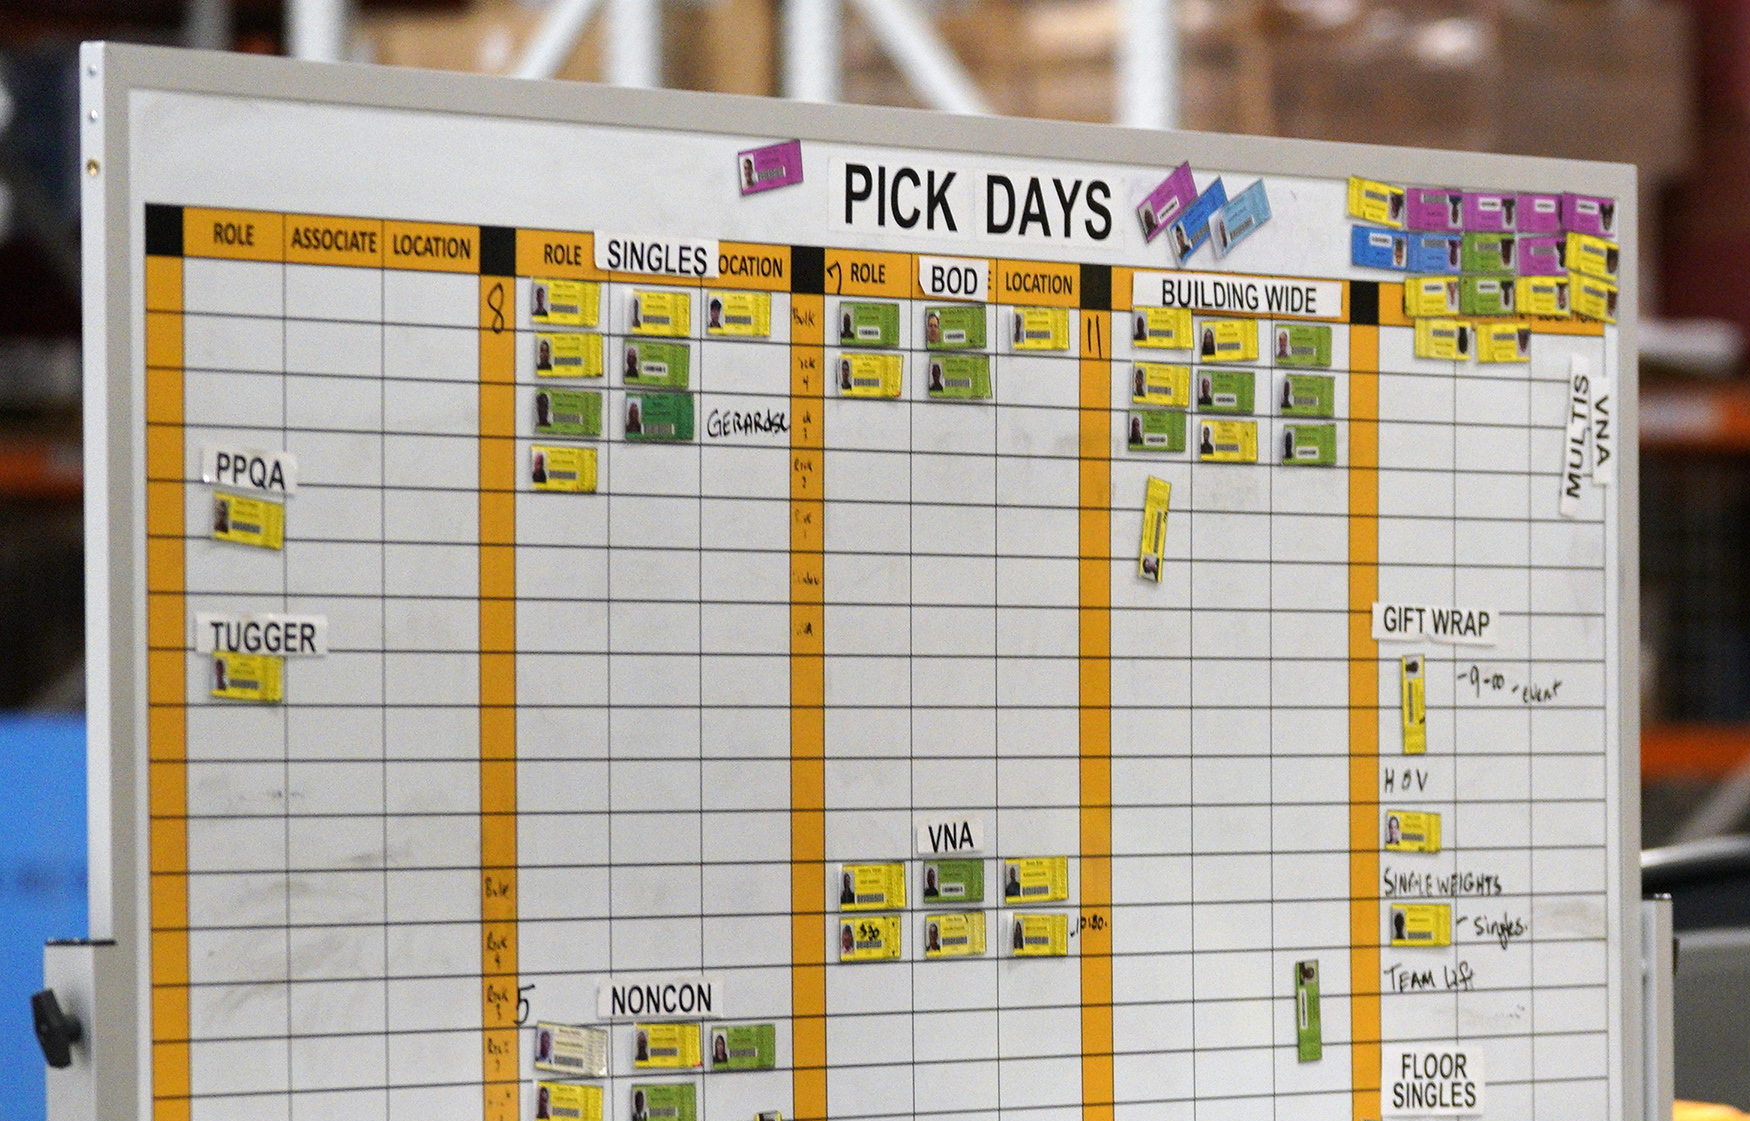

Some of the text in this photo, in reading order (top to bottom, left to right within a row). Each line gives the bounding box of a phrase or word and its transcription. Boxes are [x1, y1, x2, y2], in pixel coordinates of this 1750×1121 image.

[845, 163, 957, 232] PICK
[986, 174, 1112, 240] DAYS
[213, 222, 254, 246] ROLE
[291, 227, 377, 253] ASSOCIATE
[393, 235, 471, 260] LOCATION
[544, 244, 582, 266] ROLE
[608, 239, 707, 275] SINGLES
[718, 255, 783, 278] OCATION
[851, 263, 886, 283] ROLE
[931, 265, 978, 295] BOD
[1005, 272, 1073, 295] LOCATION
[487, 283, 505, 334] 8
[1162, 279, 1317, 313] BUILDING WIDE
[1566, 375, 1589, 498] MULTIS
[1595, 395, 1610, 466] VNA
[217, 453, 285, 490] PPQA
[1384, 606, 1490, 637] GIFT WRAP
[210, 622, 316, 653] TUGGER
[928, 821, 974, 853] VNA
[1437, 871, 1502, 897] WEIGHTS
[1384, 963, 1436, 993] TEAM
[514, 984, 535, 1025] 5
[611, 984, 712, 1015] NONCON
[1401, 1053, 1467, 1079] FLOOR
[1393, 1082, 1477, 1109] SINGLES
